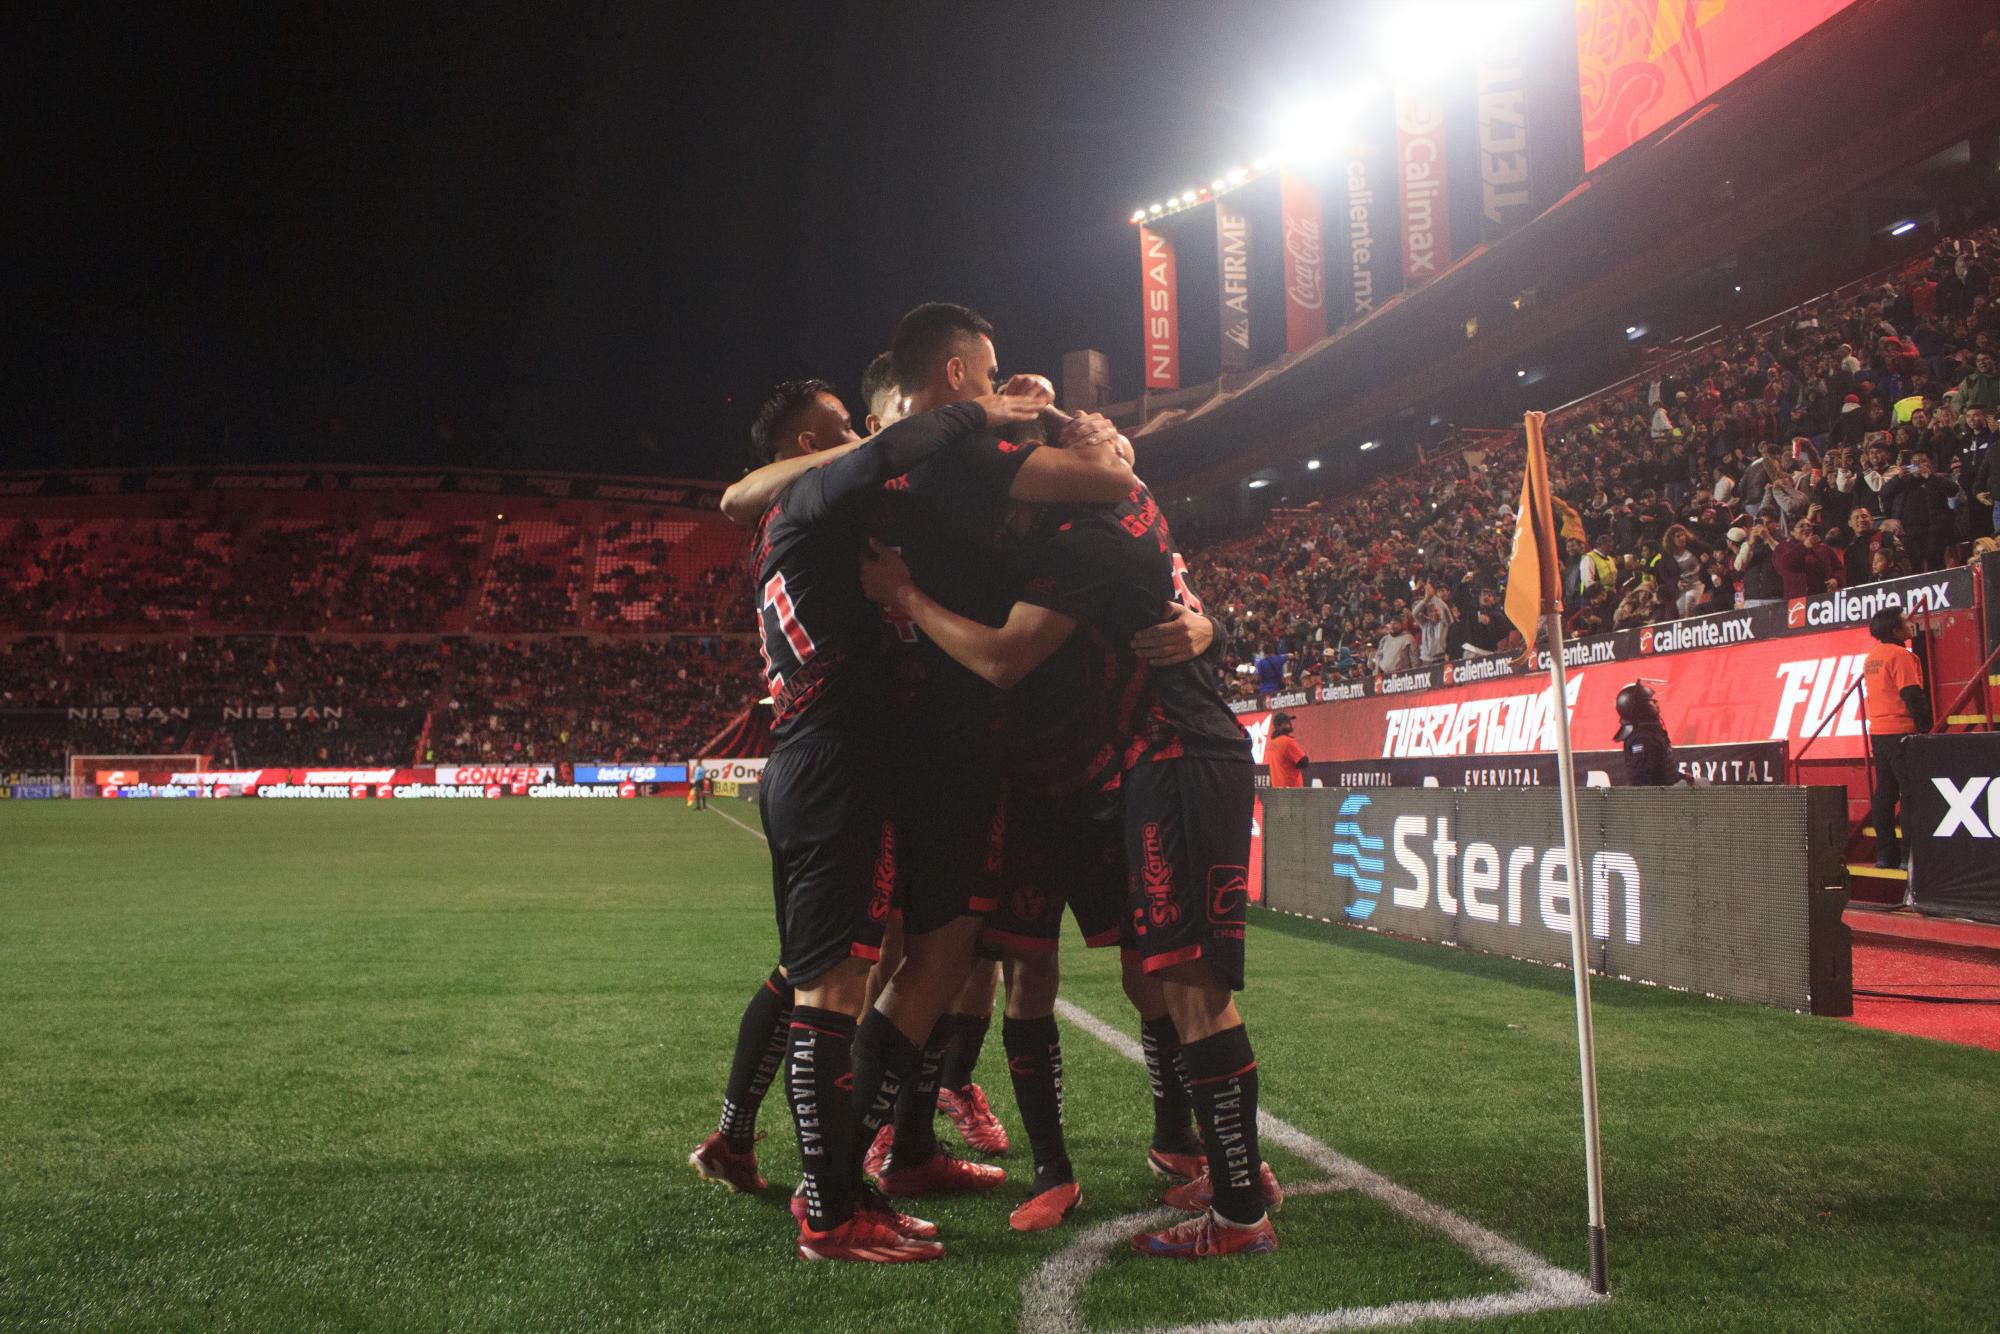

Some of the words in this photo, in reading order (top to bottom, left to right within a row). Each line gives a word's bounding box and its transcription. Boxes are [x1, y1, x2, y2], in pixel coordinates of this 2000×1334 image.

[1479, 62, 1528, 222] TECAT
[1404, 137, 1438, 272] Calimax
[1348, 159, 1374, 313] caliente.mx
[1222, 214, 1248, 312] AFIRME
[1147, 234, 1172, 380] NISSAN
[1806, 582, 1951, 627] caliente.mx
[1653, 616, 1755, 653] caliente.mx
[1453, 656, 1514, 683] caliente.mx
[1537, 640, 1616, 670] caente.mx
[1321, 682, 1366, 701] caliente.mx
[1382, 671, 1432, 694] caliente.mx
[68, 706, 190, 721] NISSAN
[223, 706, 343, 720] NISSAN
[258, 783, 350, 798] caliente.mx
[393, 783, 484, 798] caliente.mx
[455, 767, 540, 784] GONHER
[528, 783, 619, 798] caliente.mx
[1340, 772, 1393, 787] EVERVITAL
[1464, 768, 1541, 787] EVERVITAL
[1136, 821, 1180, 929] SuKarne
[1392, 814, 1642, 945] Steren
[791, 1036, 824, 1157] EVERVITAL
[1212, 1082, 1251, 1189] EVERVITAL
